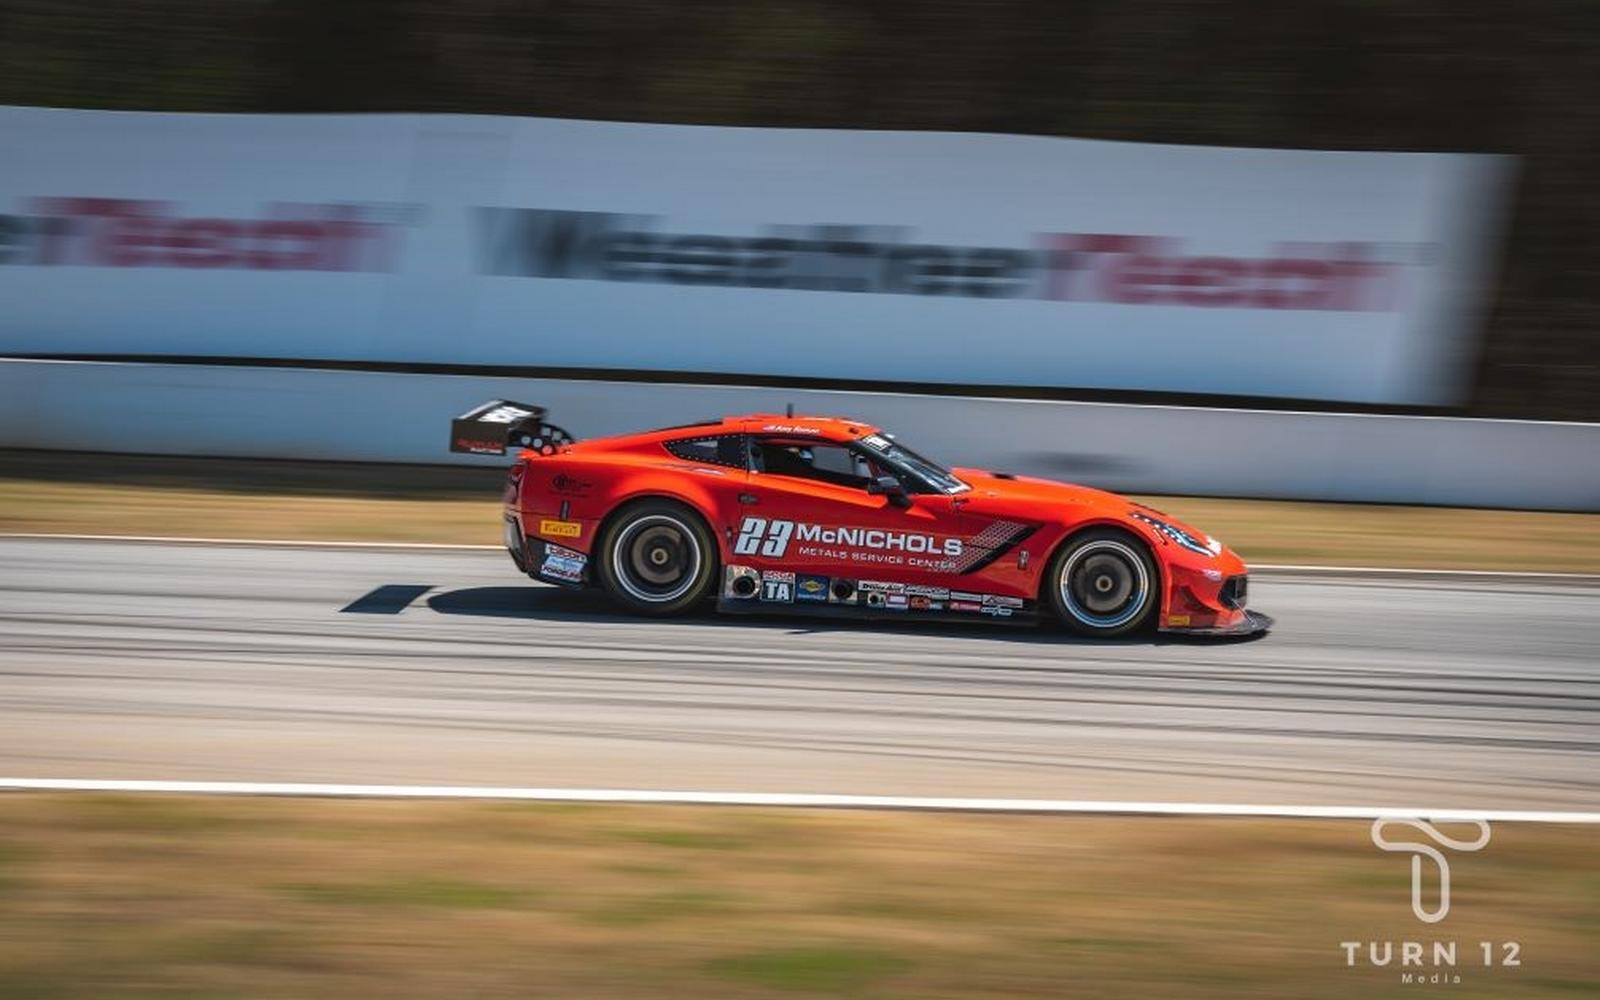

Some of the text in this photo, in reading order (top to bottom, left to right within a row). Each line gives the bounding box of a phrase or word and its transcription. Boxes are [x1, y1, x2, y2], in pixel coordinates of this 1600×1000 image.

[734, 516, 795, 558] 23
[796, 523, 964, 556] McNICHOLS
[799, 547, 848, 559] METALS
[851, 552, 903, 564] SERVICE
[765, 582, 790, 600] TA
